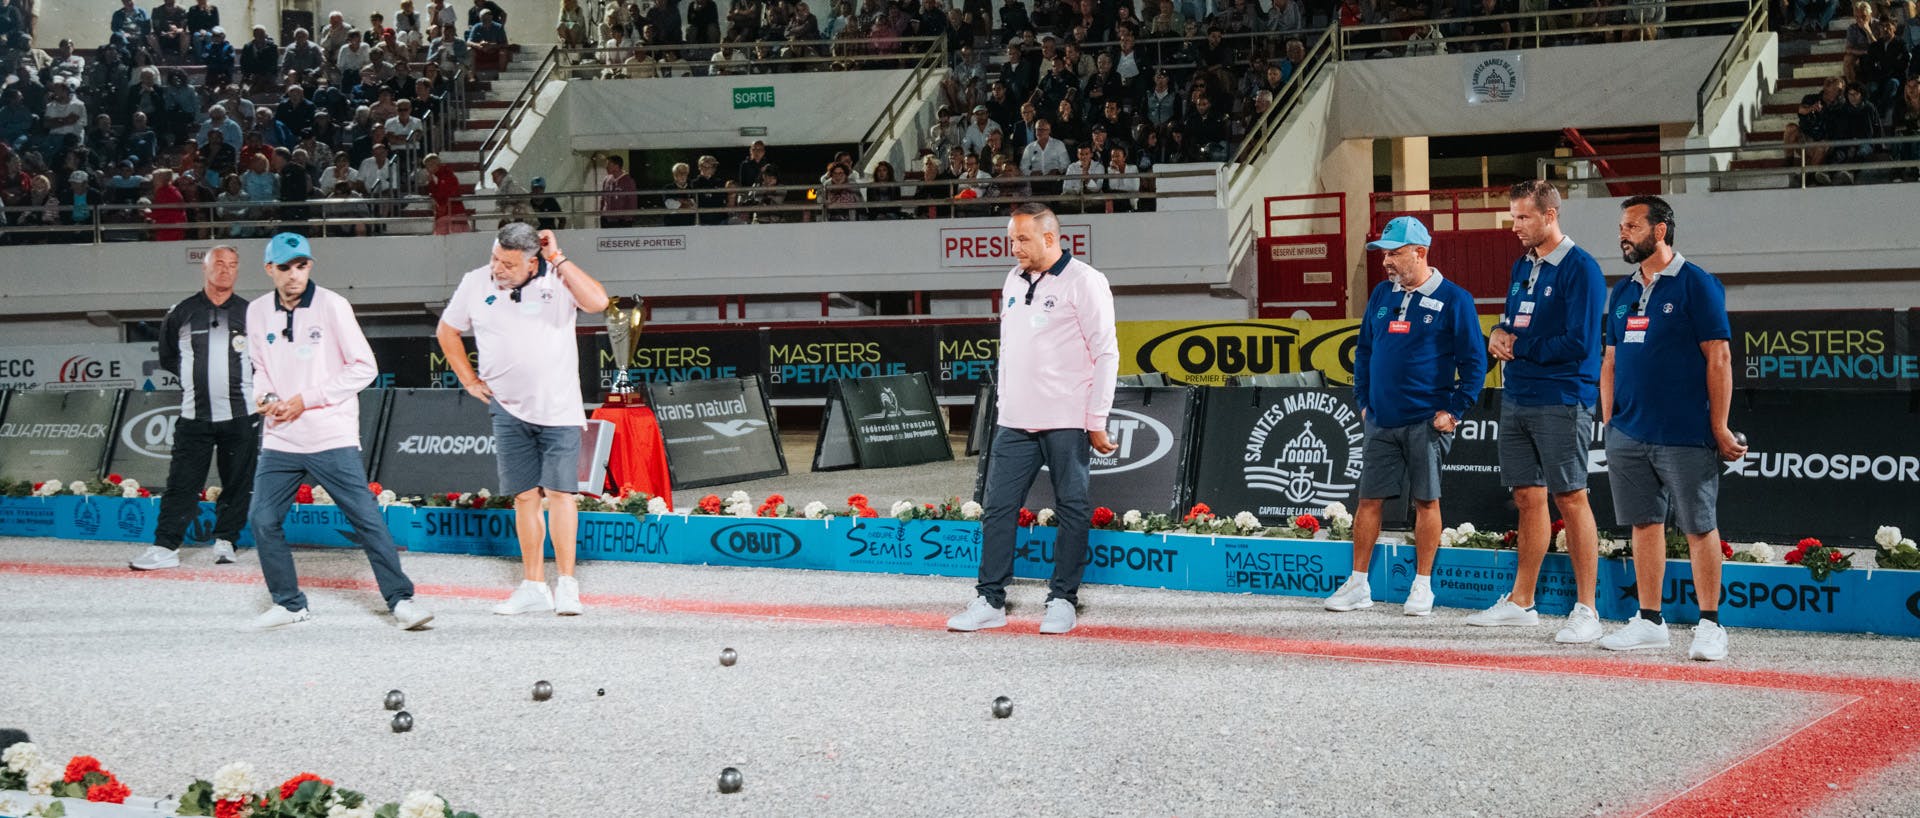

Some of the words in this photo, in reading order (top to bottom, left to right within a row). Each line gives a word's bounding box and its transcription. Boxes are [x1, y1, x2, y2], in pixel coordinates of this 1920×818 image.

[735, 92, 773, 103] SORTIE
[643, 238, 682, 247] PORTIER
[769, 342, 881, 364] MASTERS
[939, 339, 1001, 360] MAST
[1745, 330, 1885, 354] MASTERS
[1178, 335, 1296, 374] OBUT
[601, 369, 612, 388] DE
[770, 365, 782, 384] DE
[941, 361, 951, 381] DE
[1185, 374, 1219, 383] PREMIER
[1746, 356, 1758, 378] DE
[1759, 354, 1920, 381] PETANQUE
[656, 403, 695, 420] trans
[696, 395, 747, 418] natural
[1283, 391, 1337, 415] MARIES
[1333, 403, 1356, 427] DE
[0, 423, 108, 438] QUARTERBACK
[1244, 404, 1285, 461] SAINTES
[1344, 421, 1365, 445] LA
[397, 435, 498, 455] EUROSPOR
[1089, 457, 1118, 466] TANQUE
[1344, 446, 1364, 479] MER
[1441, 464, 1492, 472] RANSPORTEUR
[290, 509, 329, 525] trans
[1259, 506, 1286, 516] CAPITALE
[1286, 507, 1295, 517] DE
[1295, 508, 1303, 517] LA
[425, 512, 517, 538] SHILTON
[577, 520, 669, 555] RTERBACK
[729, 531, 782, 554] OBUT
[920, 525, 979, 562] SEMI
[1015, 540, 1178, 573] EUSPORT
[1225, 551, 1324, 573] MASTERS
[1226, 571, 1236, 587] DE
[1432, 567, 1514, 580] édération
[1440, 579, 1495, 592] Pétanque
[1618, 578, 1840, 613] URSPORT
